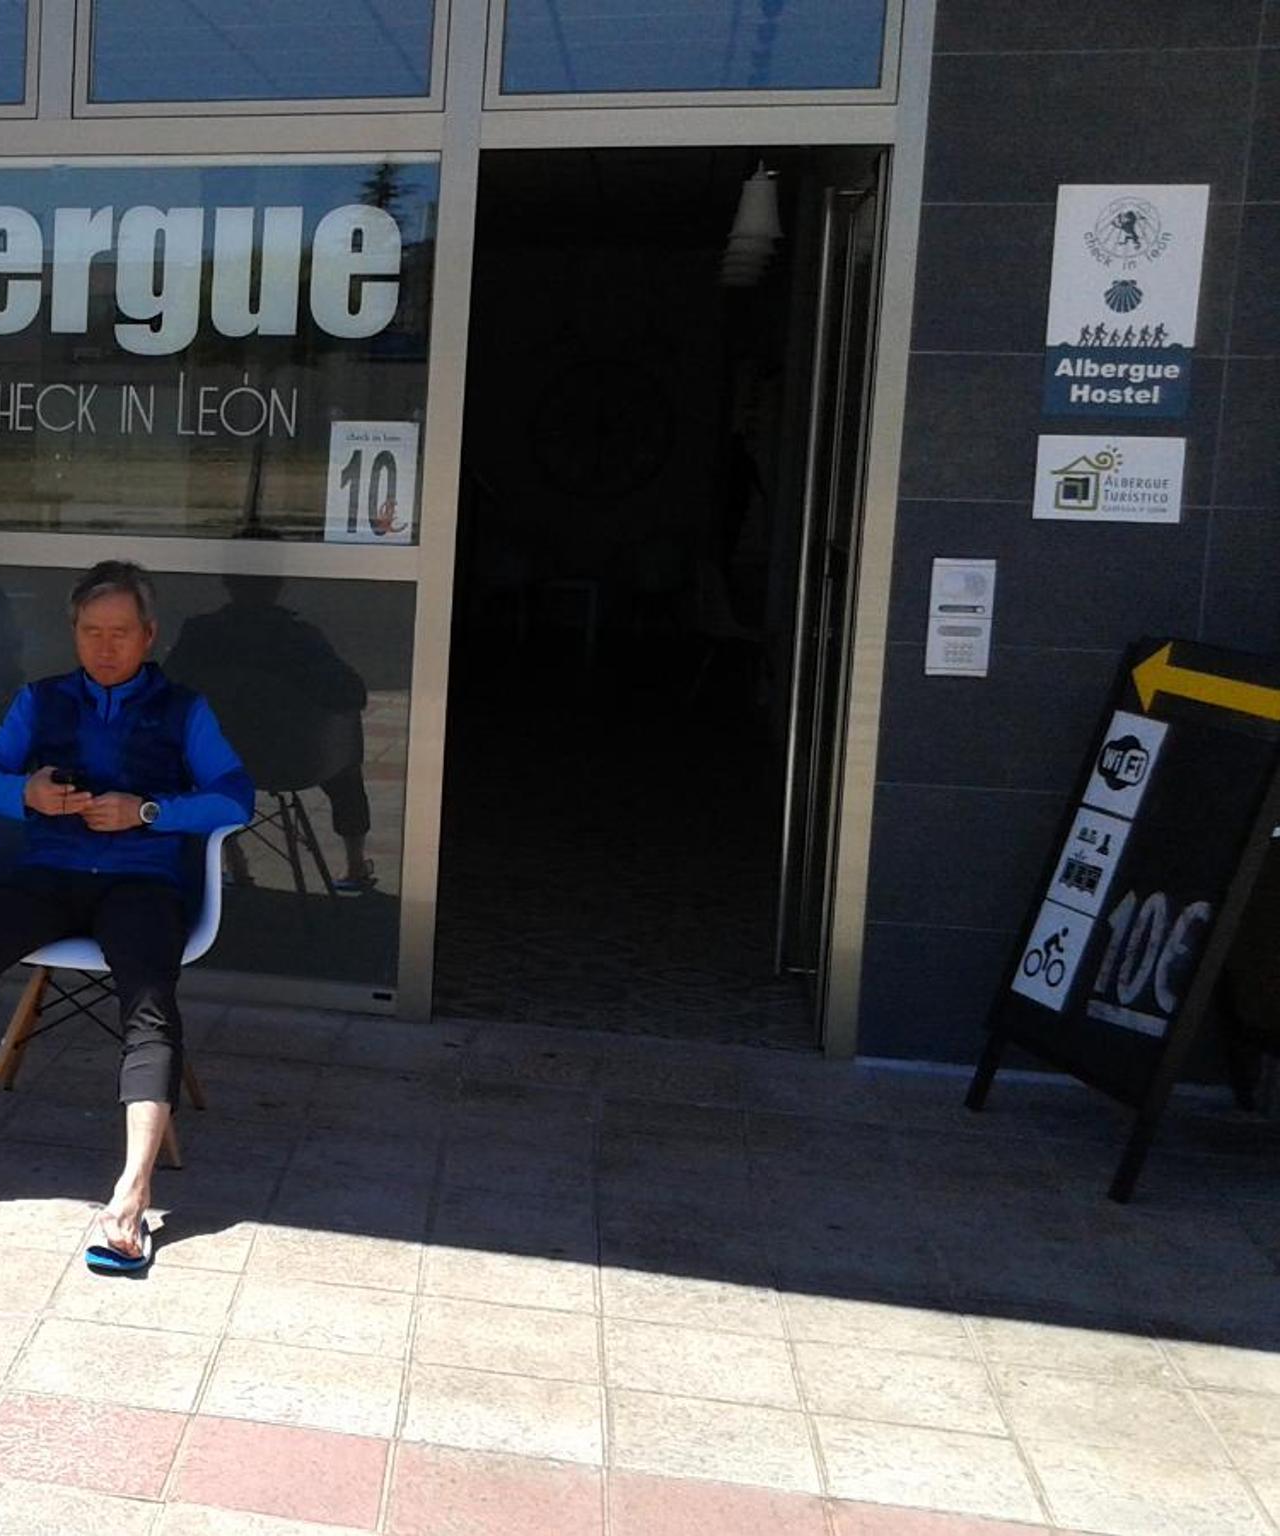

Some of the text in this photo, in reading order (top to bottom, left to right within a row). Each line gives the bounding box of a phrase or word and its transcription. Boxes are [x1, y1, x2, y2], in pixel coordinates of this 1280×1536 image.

[1083, 231, 1112, 268] check
[1122, 260, 1137, 271] in
[1054, 358, 1180, 383] Albergue
[121, 384, 154, 434] IN
[177, 371, 297, 437] LEÓN
[1070, 383, 1160, 404] Hostel
[1103, 475, 1170, 490] ALBERGUE
